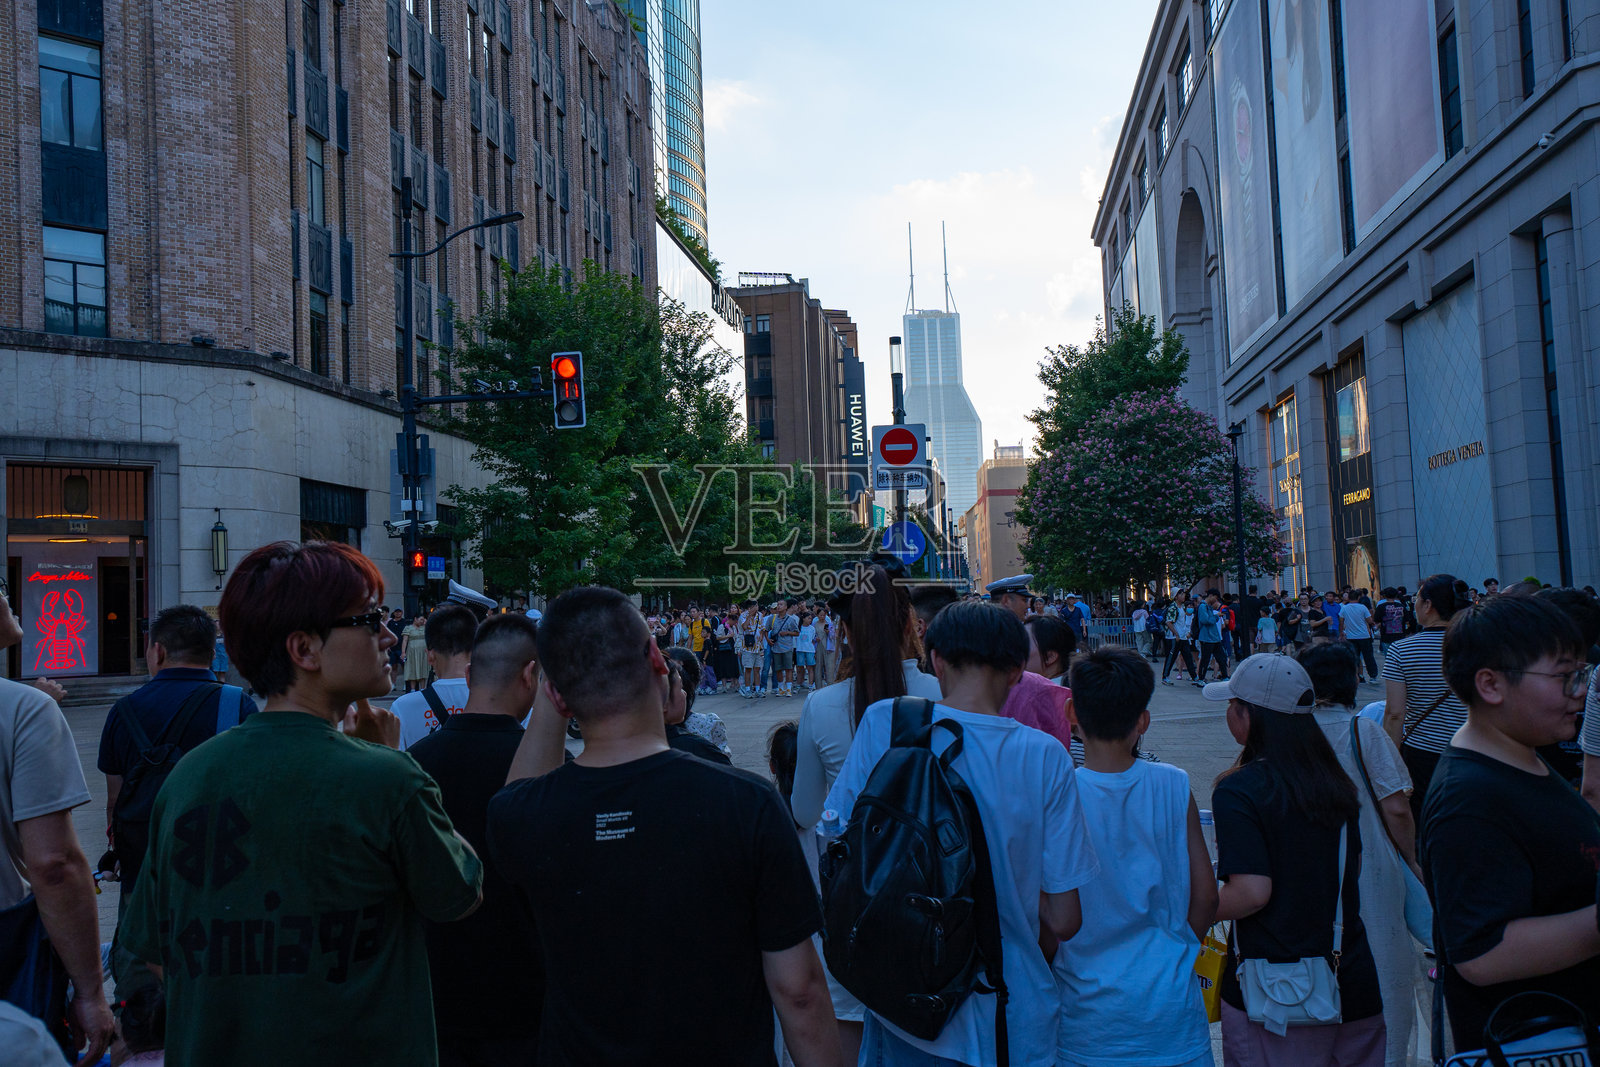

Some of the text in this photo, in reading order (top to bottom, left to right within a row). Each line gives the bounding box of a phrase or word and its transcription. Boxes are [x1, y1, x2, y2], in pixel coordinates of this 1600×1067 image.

[850, 394, 864, 456] HUAWEI
[1428, 440, 1485, 471] BOTTEGA VENETA
[1343, 487, 1371, 505] FERRAGAMO
